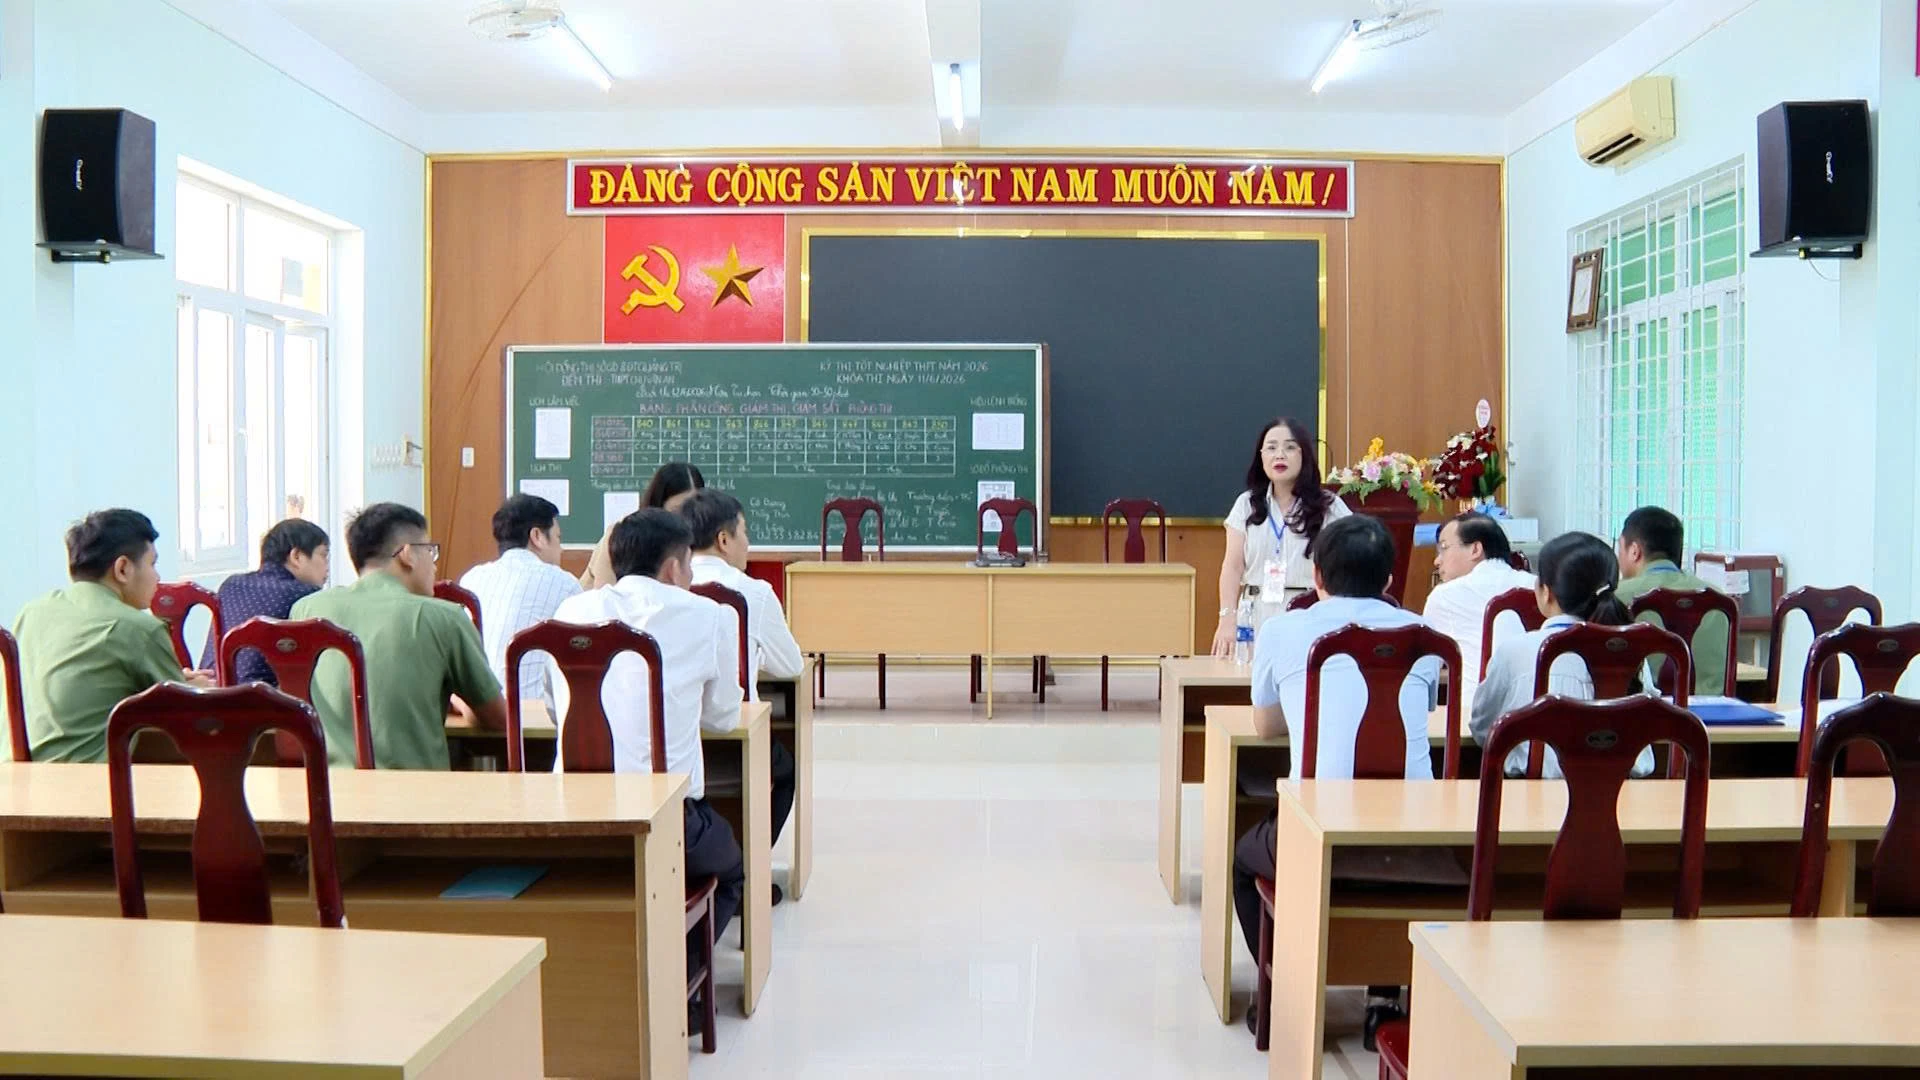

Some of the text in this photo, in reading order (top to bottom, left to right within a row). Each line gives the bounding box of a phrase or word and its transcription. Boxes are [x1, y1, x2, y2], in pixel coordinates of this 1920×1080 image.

[589, 162, 693, 204] ĐẢNG
[707, 161, 804, 207] CỘNG
[816, 161, 894, 203] SẢN
[905, 160, 1001, 207] VIỆT
[1010, 167, 1099, 203] NAM
[1112, 163, 1216, 204] MUÔN
